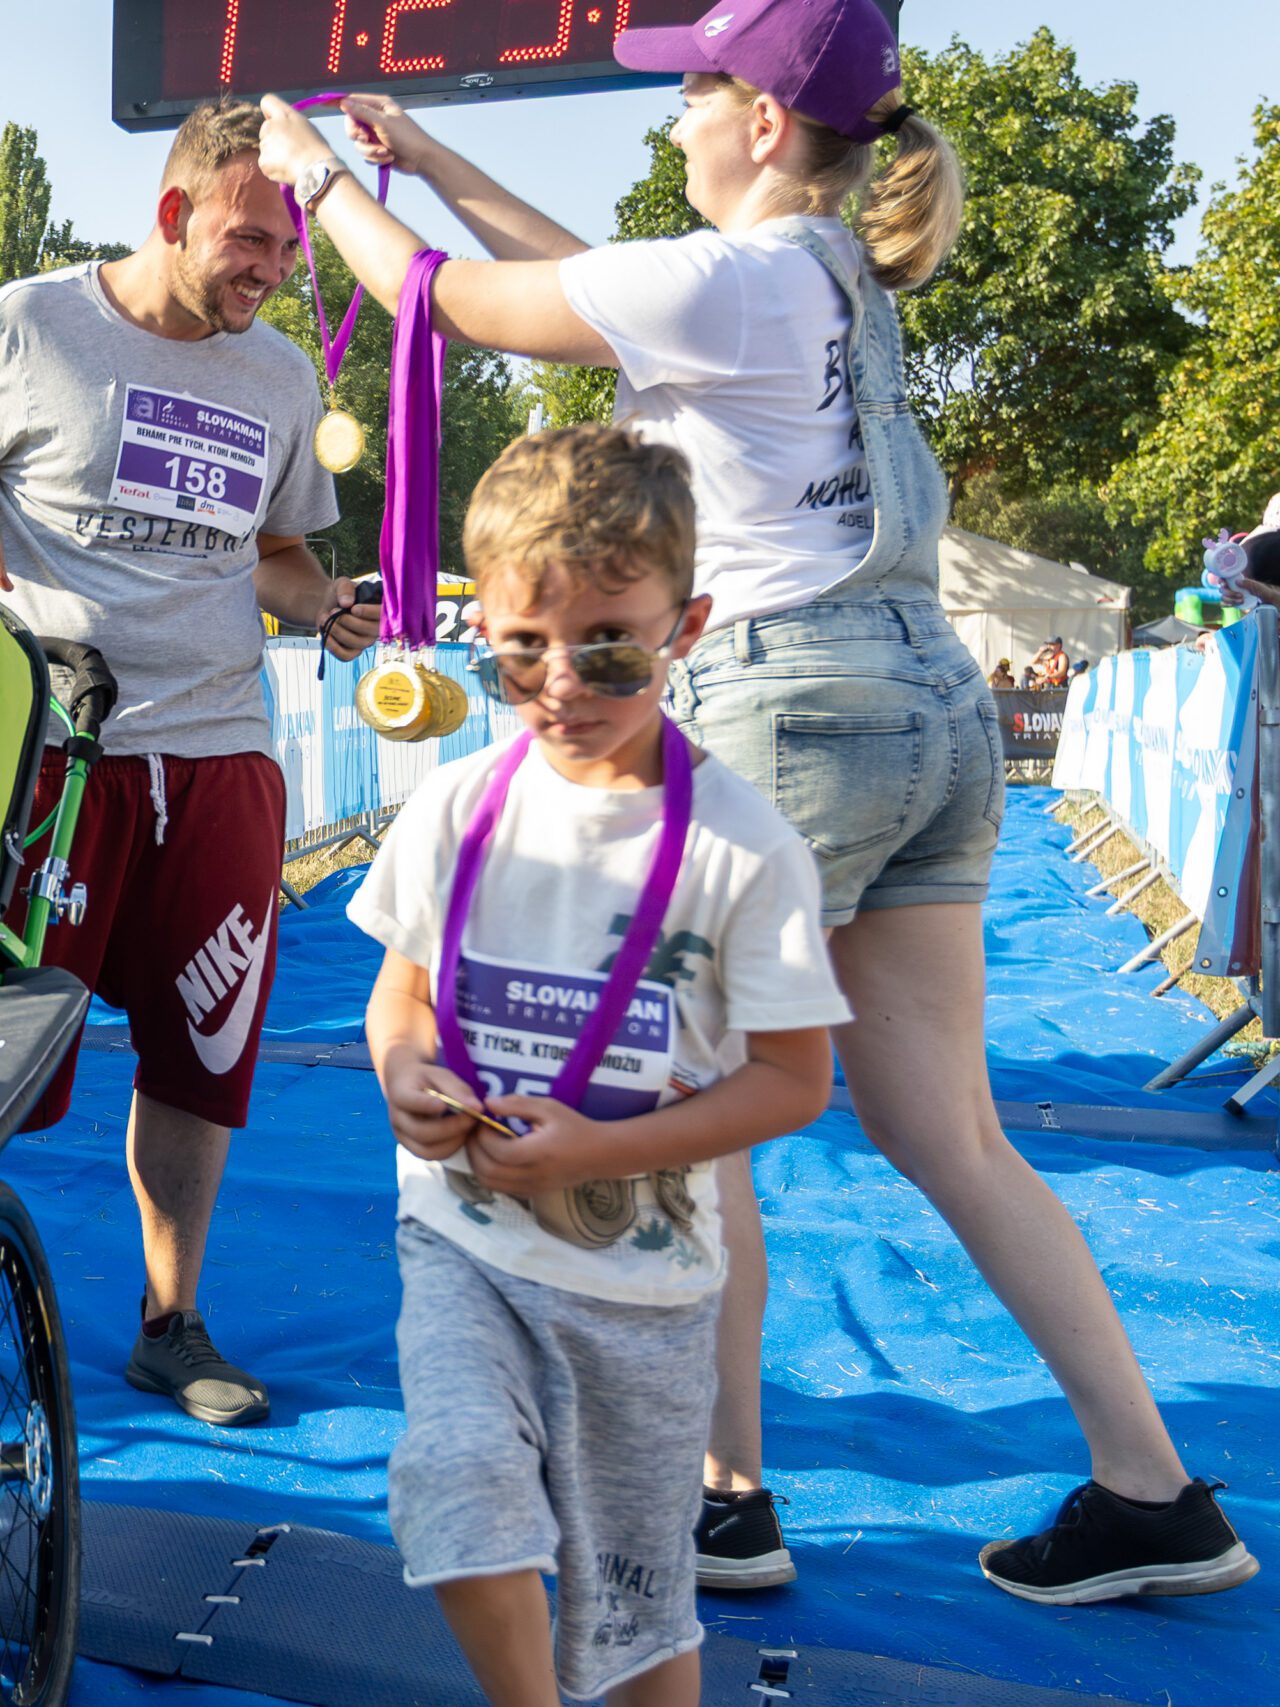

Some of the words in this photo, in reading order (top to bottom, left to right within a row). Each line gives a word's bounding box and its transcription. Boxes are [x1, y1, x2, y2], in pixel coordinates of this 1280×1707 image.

[168, 433, 183, 446] PRE
[196, 410, 262, 442] SLOVAKMAN
[164, 456, 227, 499] 158
[837, 512, 873, 530] ADEL
[175, 903, 261, 1026] NIKE
[505, 980, 663, 1022] SLOVAAN
[506, 1003, 662, 1038] TRIATON
[531, 1041, 572, 1062] KTOR
